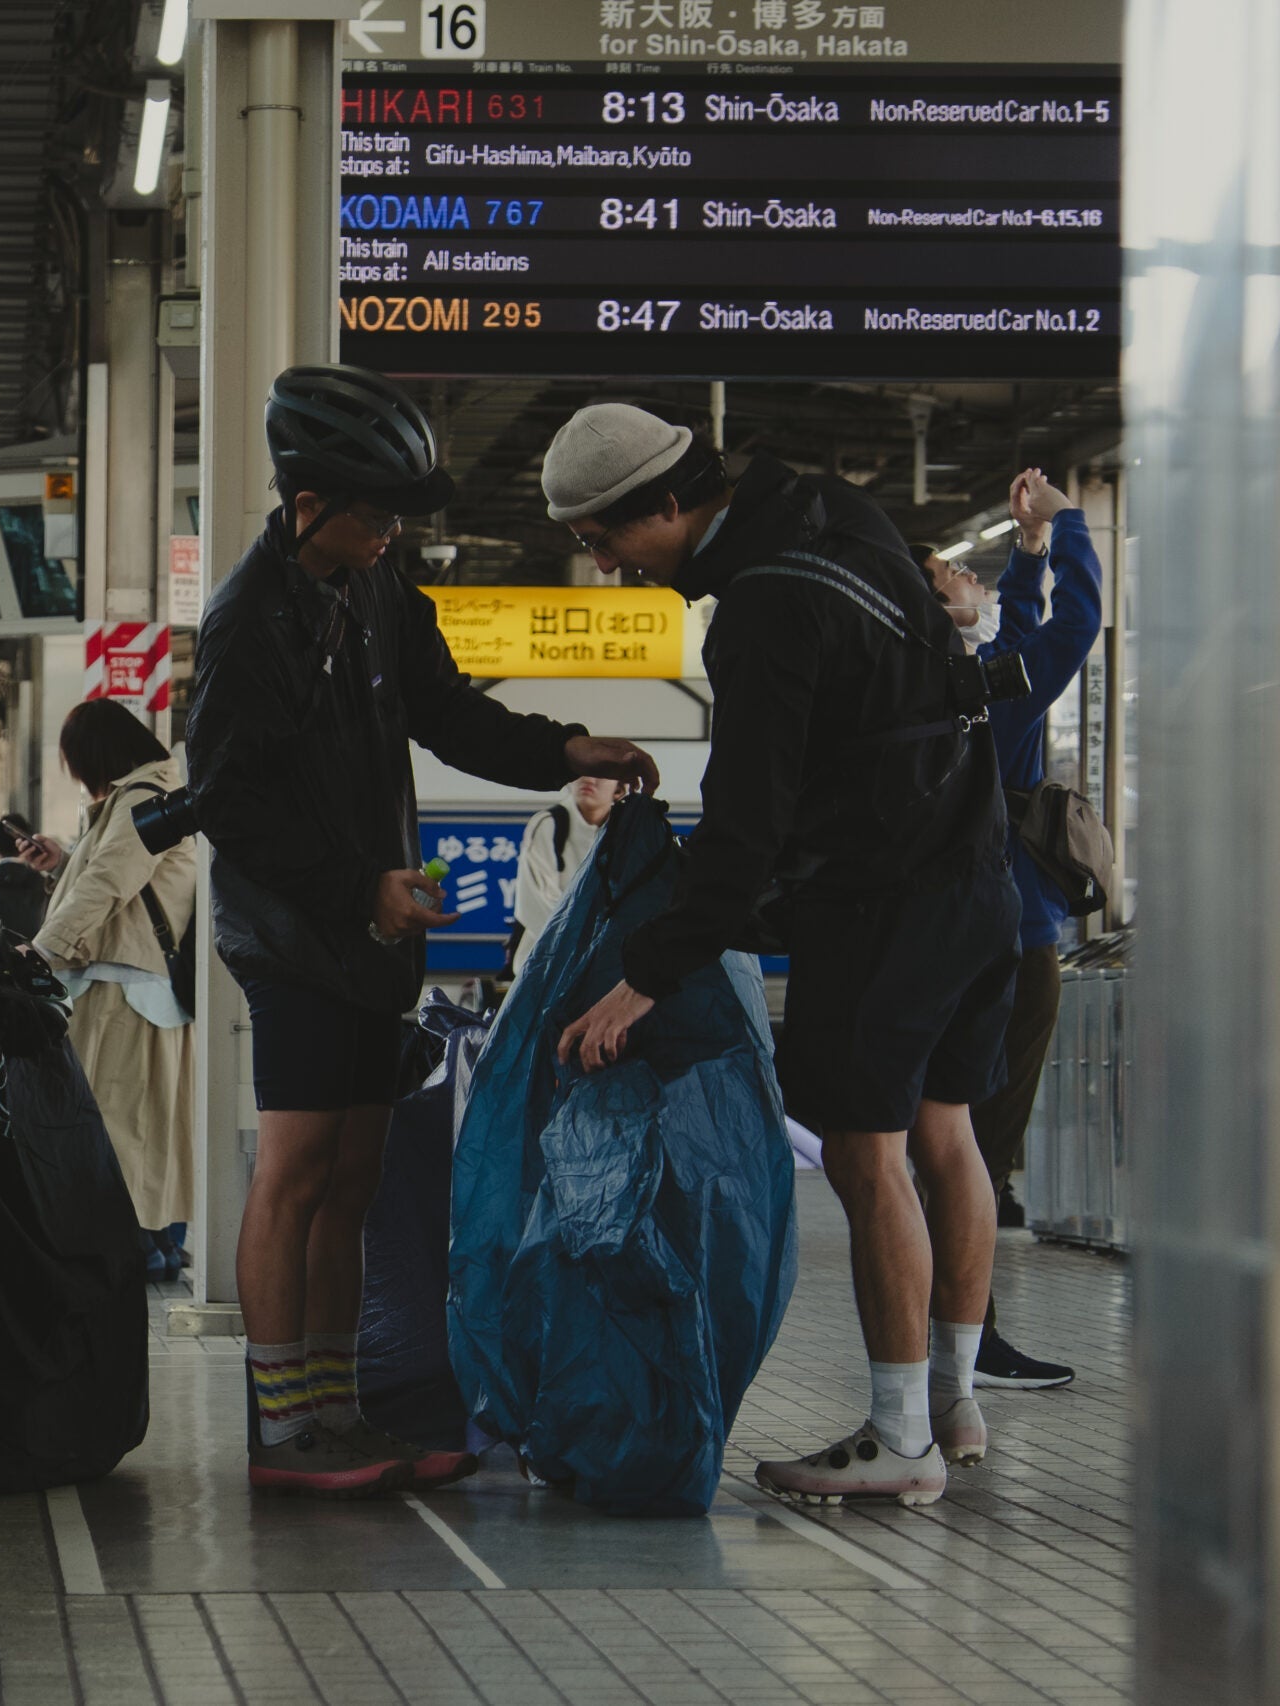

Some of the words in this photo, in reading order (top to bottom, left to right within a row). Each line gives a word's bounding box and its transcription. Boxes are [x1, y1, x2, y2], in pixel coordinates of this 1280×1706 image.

[428, 4, 476, 50] 16
[600, 34, 638, 56] for
[817, 35, 908, 56] Hakata
[382, 62, 407, 72] Train
[529, 63, 553, 73] Train
[635, 64, 661, 73] Time
[735, 64, 794, 73] Destination
[341, 89, 473, 123] HIKARI
[488, 95, 543, 118] 631
[602, 91, 685, 123] 8:13
[705, 93, 839, 122] Shin-Ōsaka
[1005, 100, 1040, 122] Car
[341, 131, 373, 151] This
[374, 131, 410, 151] train
[340, 156, 383, 177] stops
[340, 195, 470, 229] KODAMA
[485, 200, 544, 225] 767
[600, 198, 678, 229] 8:41
[702, 200, 836, 228] Shin-Ōsaka
[339, 236, 370, 258] This
[371, 236, 408, 258] train
[423, 250, 449, 271] All
[452, 250, 529, 271] stations
[339, 262, 381, 283] stops
[339, 296, 469, 332] NOZOMI
[483, 302, 542, 328] 295
[597, 300, 680, 331] 8:47
[699, 302, 833, 331] Shin-Ōsaka
[998, 308, 1033, 331] Car
[530, 642, 595, 661] North
[602, 642, 647, 661] Exit
